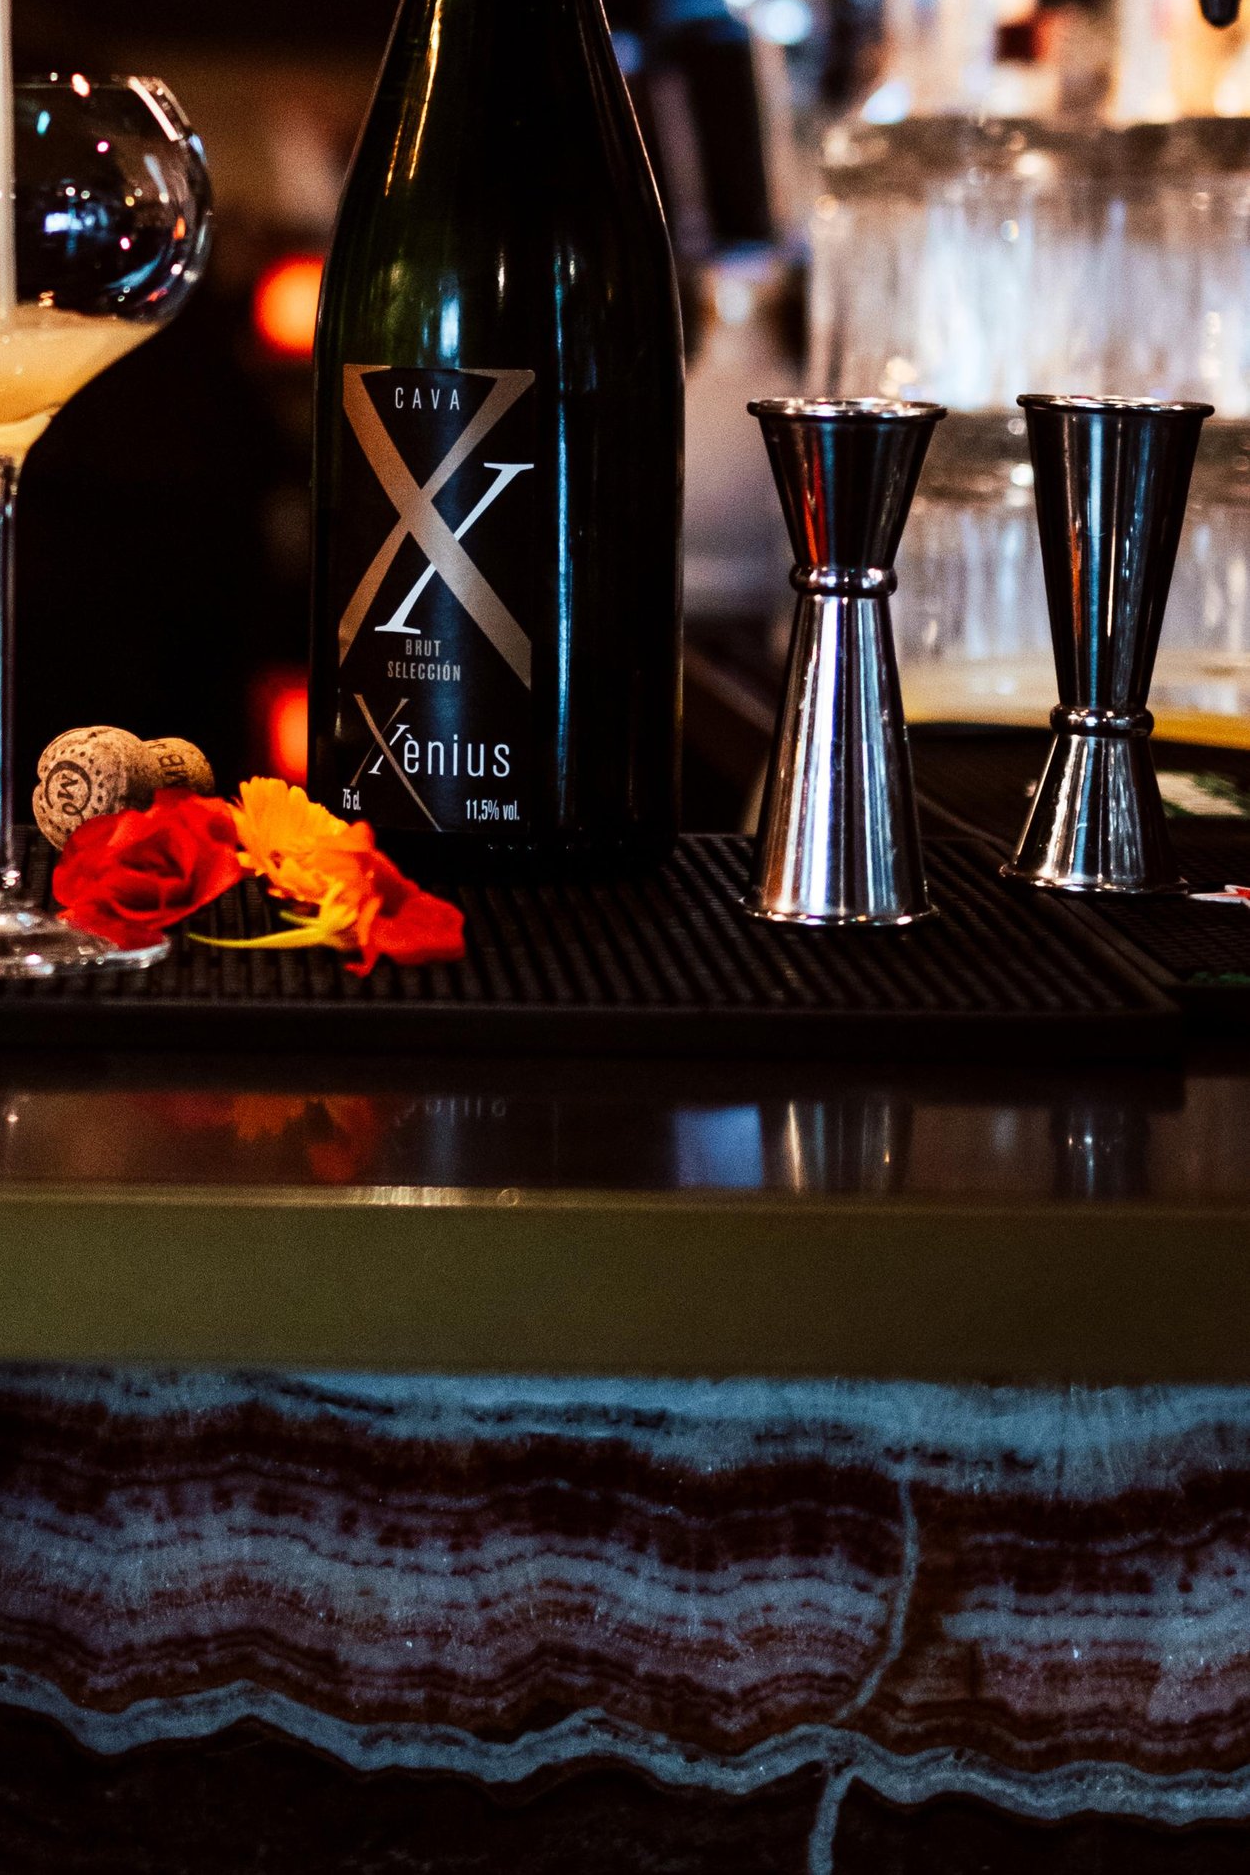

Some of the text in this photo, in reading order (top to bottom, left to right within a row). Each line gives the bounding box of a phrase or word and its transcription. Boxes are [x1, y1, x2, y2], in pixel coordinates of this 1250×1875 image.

[394, 387, 460, 411] CAVA
[405, 638, 442, 658] BRUT
[387, 660, 462, 682] SELECCIÓN
[349, 692, 512, 833] Xènius
[342, 788, 351, 810] 75
[465, 799, 520, 823] 11,5% vol.
